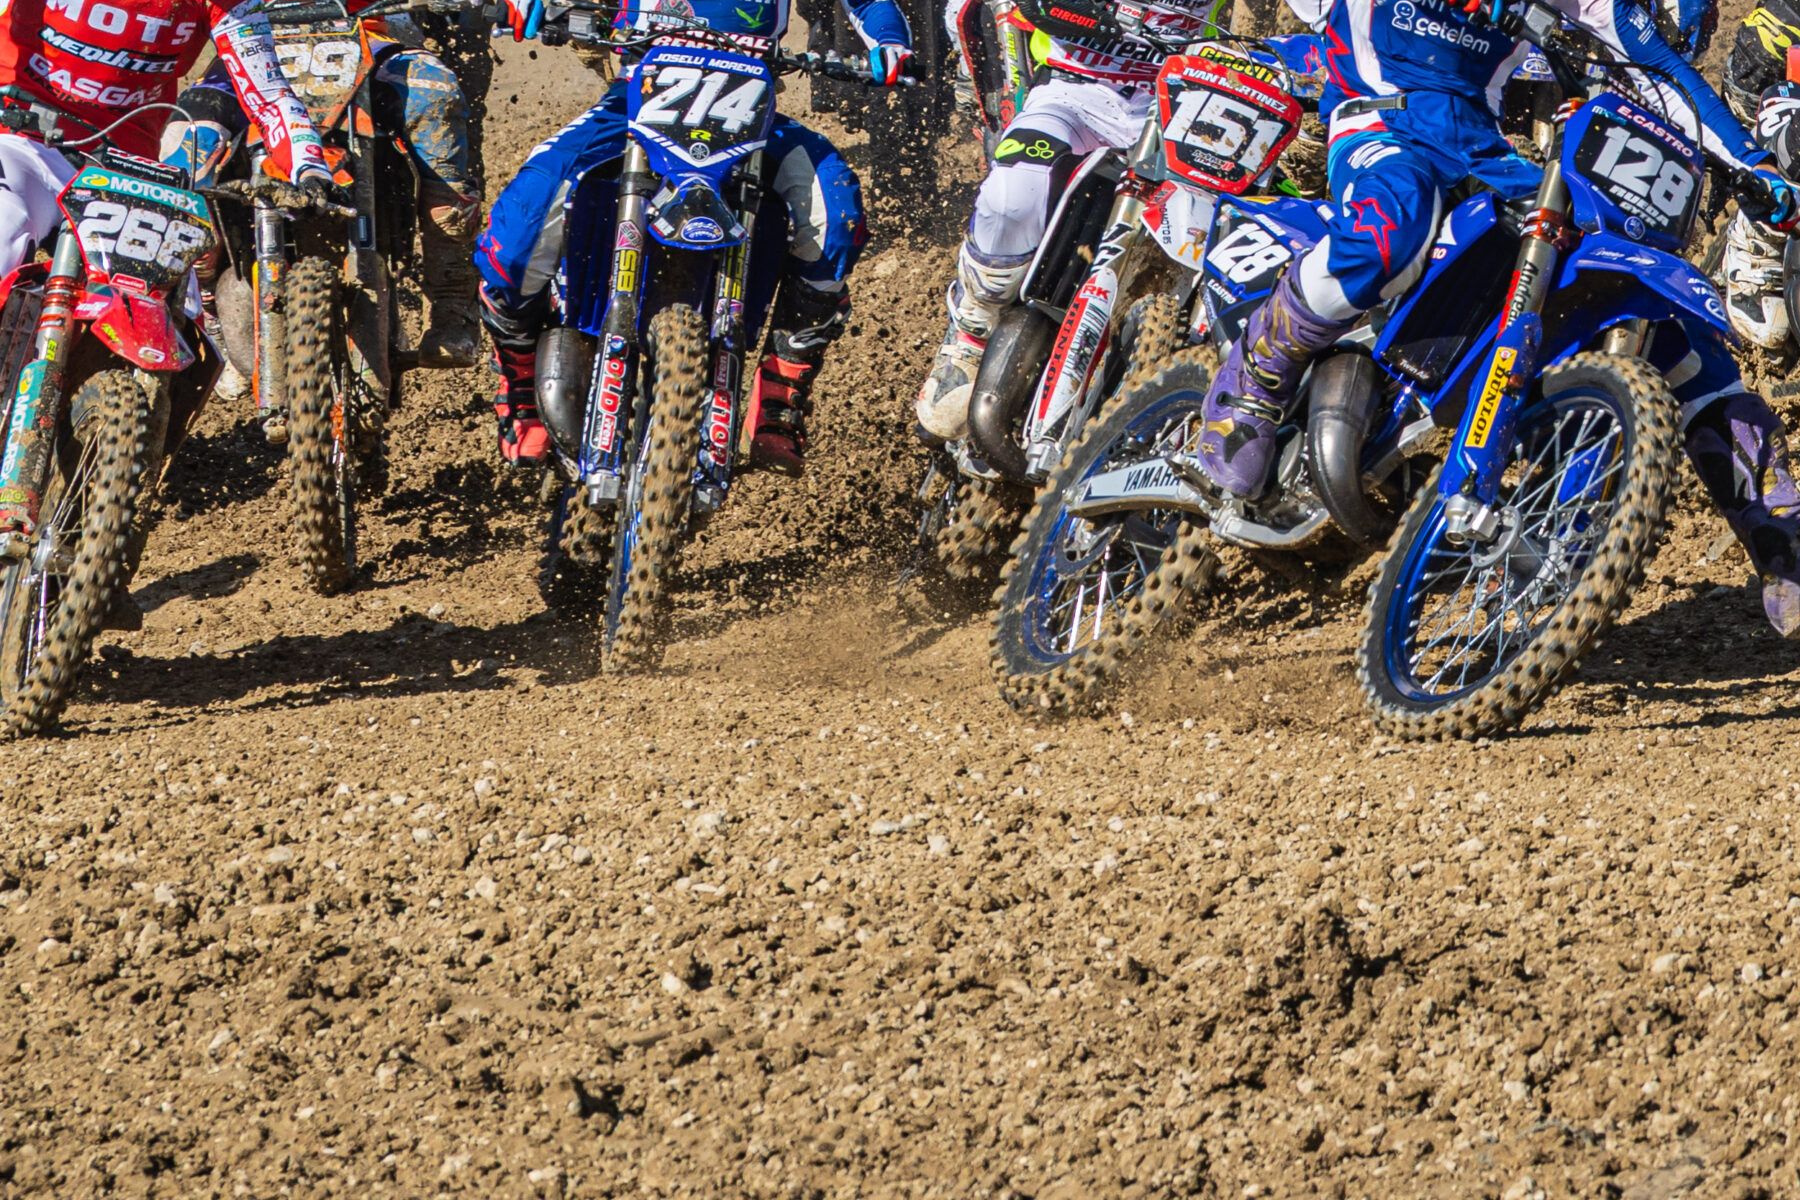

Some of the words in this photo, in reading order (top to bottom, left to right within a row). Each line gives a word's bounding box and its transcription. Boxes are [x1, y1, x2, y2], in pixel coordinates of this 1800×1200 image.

[1049, 6, 1098, 30] CIRCUIT
[1414, 16, 1491, 55] cetelem
[28, 52, 163, 108] GASGAS
[653, 51, 706, 68] JOSELU
[708, 57, 765, 77] MORENO
[1183, 67, 1217, 83] IVAN
[1200, 46, 1276, 84] CIRCUIT
[635, 66, 768, 134] 214
[1163, 89, 1284, 175] 151
[1616, 105, 1695, 158] E.CASTRO
[112, 158, 175, 180] wrpracing.com
[1591, 125, 1695, 217] 128
[109, 176, 199, 215] MOTOREX
[1608, 184, 1671, 228] RUEDA
[77, 200, 207, 274] 268
[1206, 223, 1292, 284] 128
[1083, 285, 1111, 300] RK
[1400, 358, 1416, 372] Twin
[1472, 362, 1512, 448] DUNLOP
[1123, 466, 1183, 493] YAMAHA
